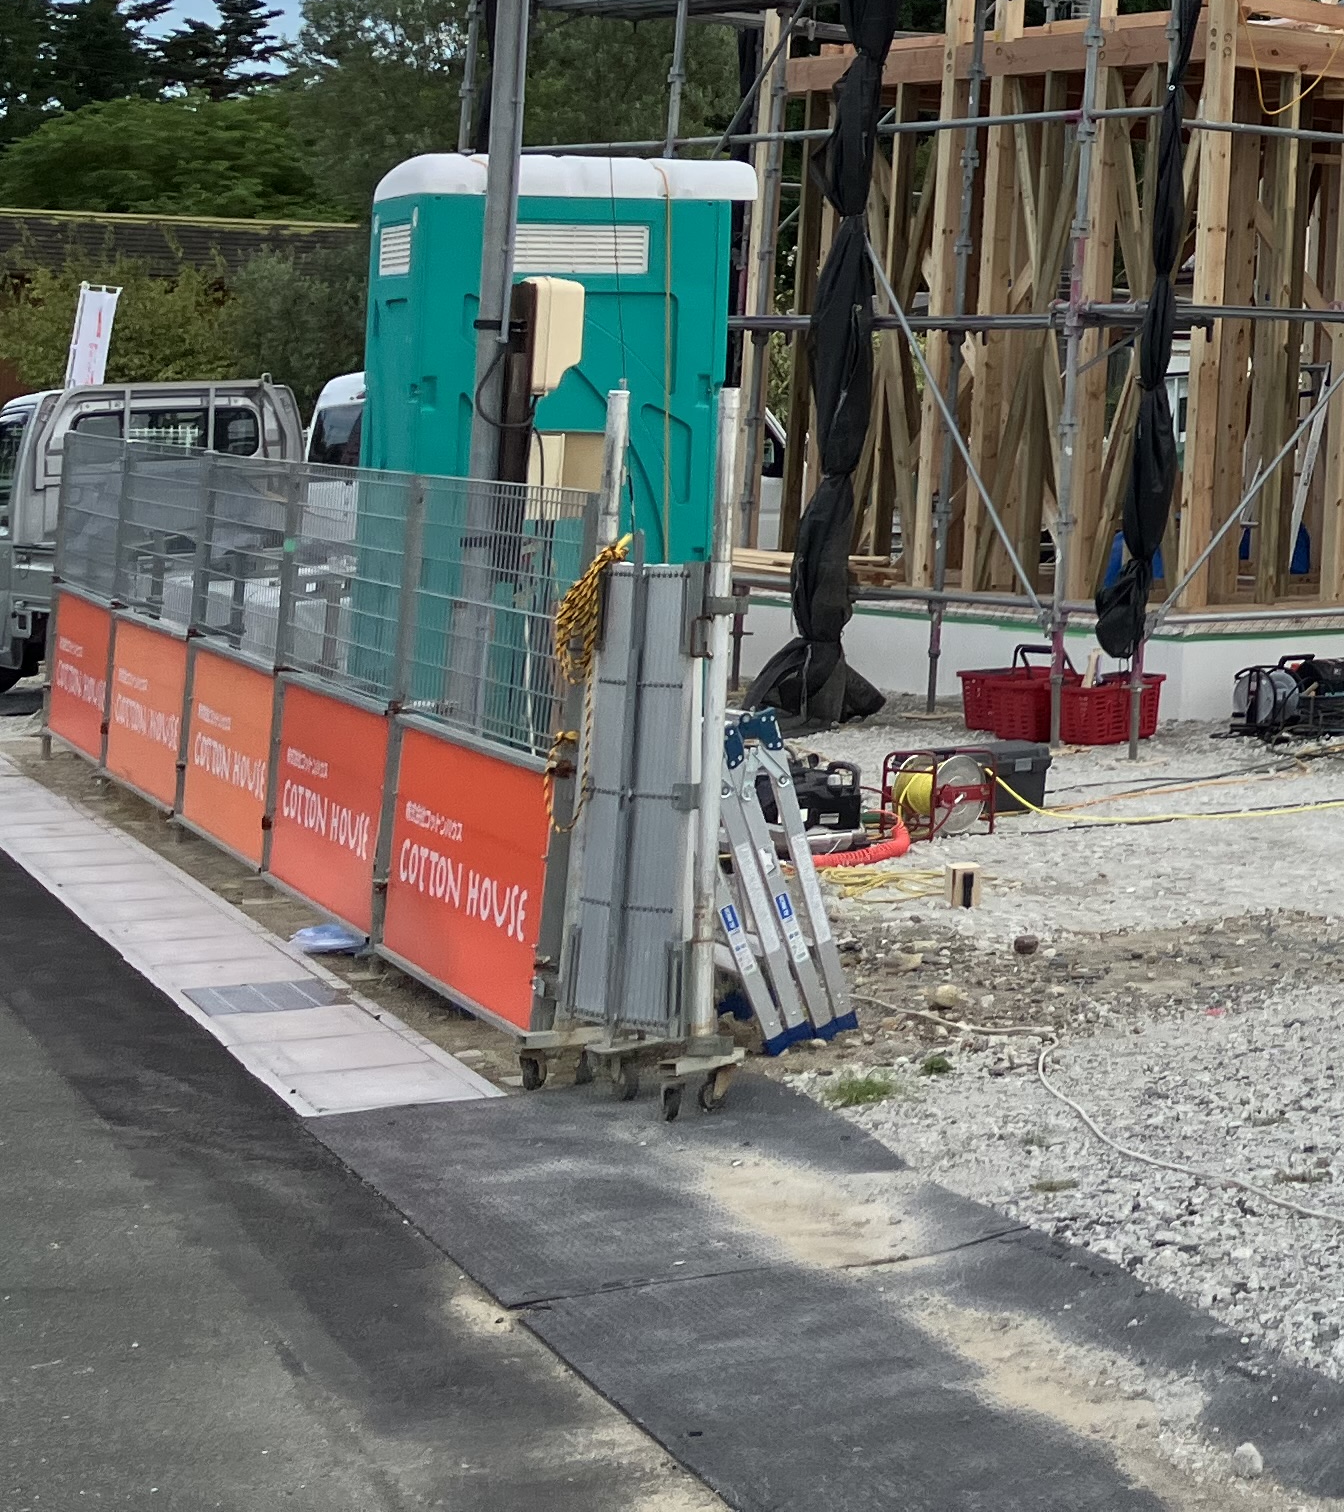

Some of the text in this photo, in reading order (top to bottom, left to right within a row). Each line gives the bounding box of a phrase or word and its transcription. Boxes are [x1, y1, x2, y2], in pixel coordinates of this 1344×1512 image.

[195, 731, 231, 781] COTTON
[232, 749, 266, 801] HOUSE
[282, 779, 370, 861] COTTON HOUSE
[400, 838, 528, 942] COTTON HOUSE
